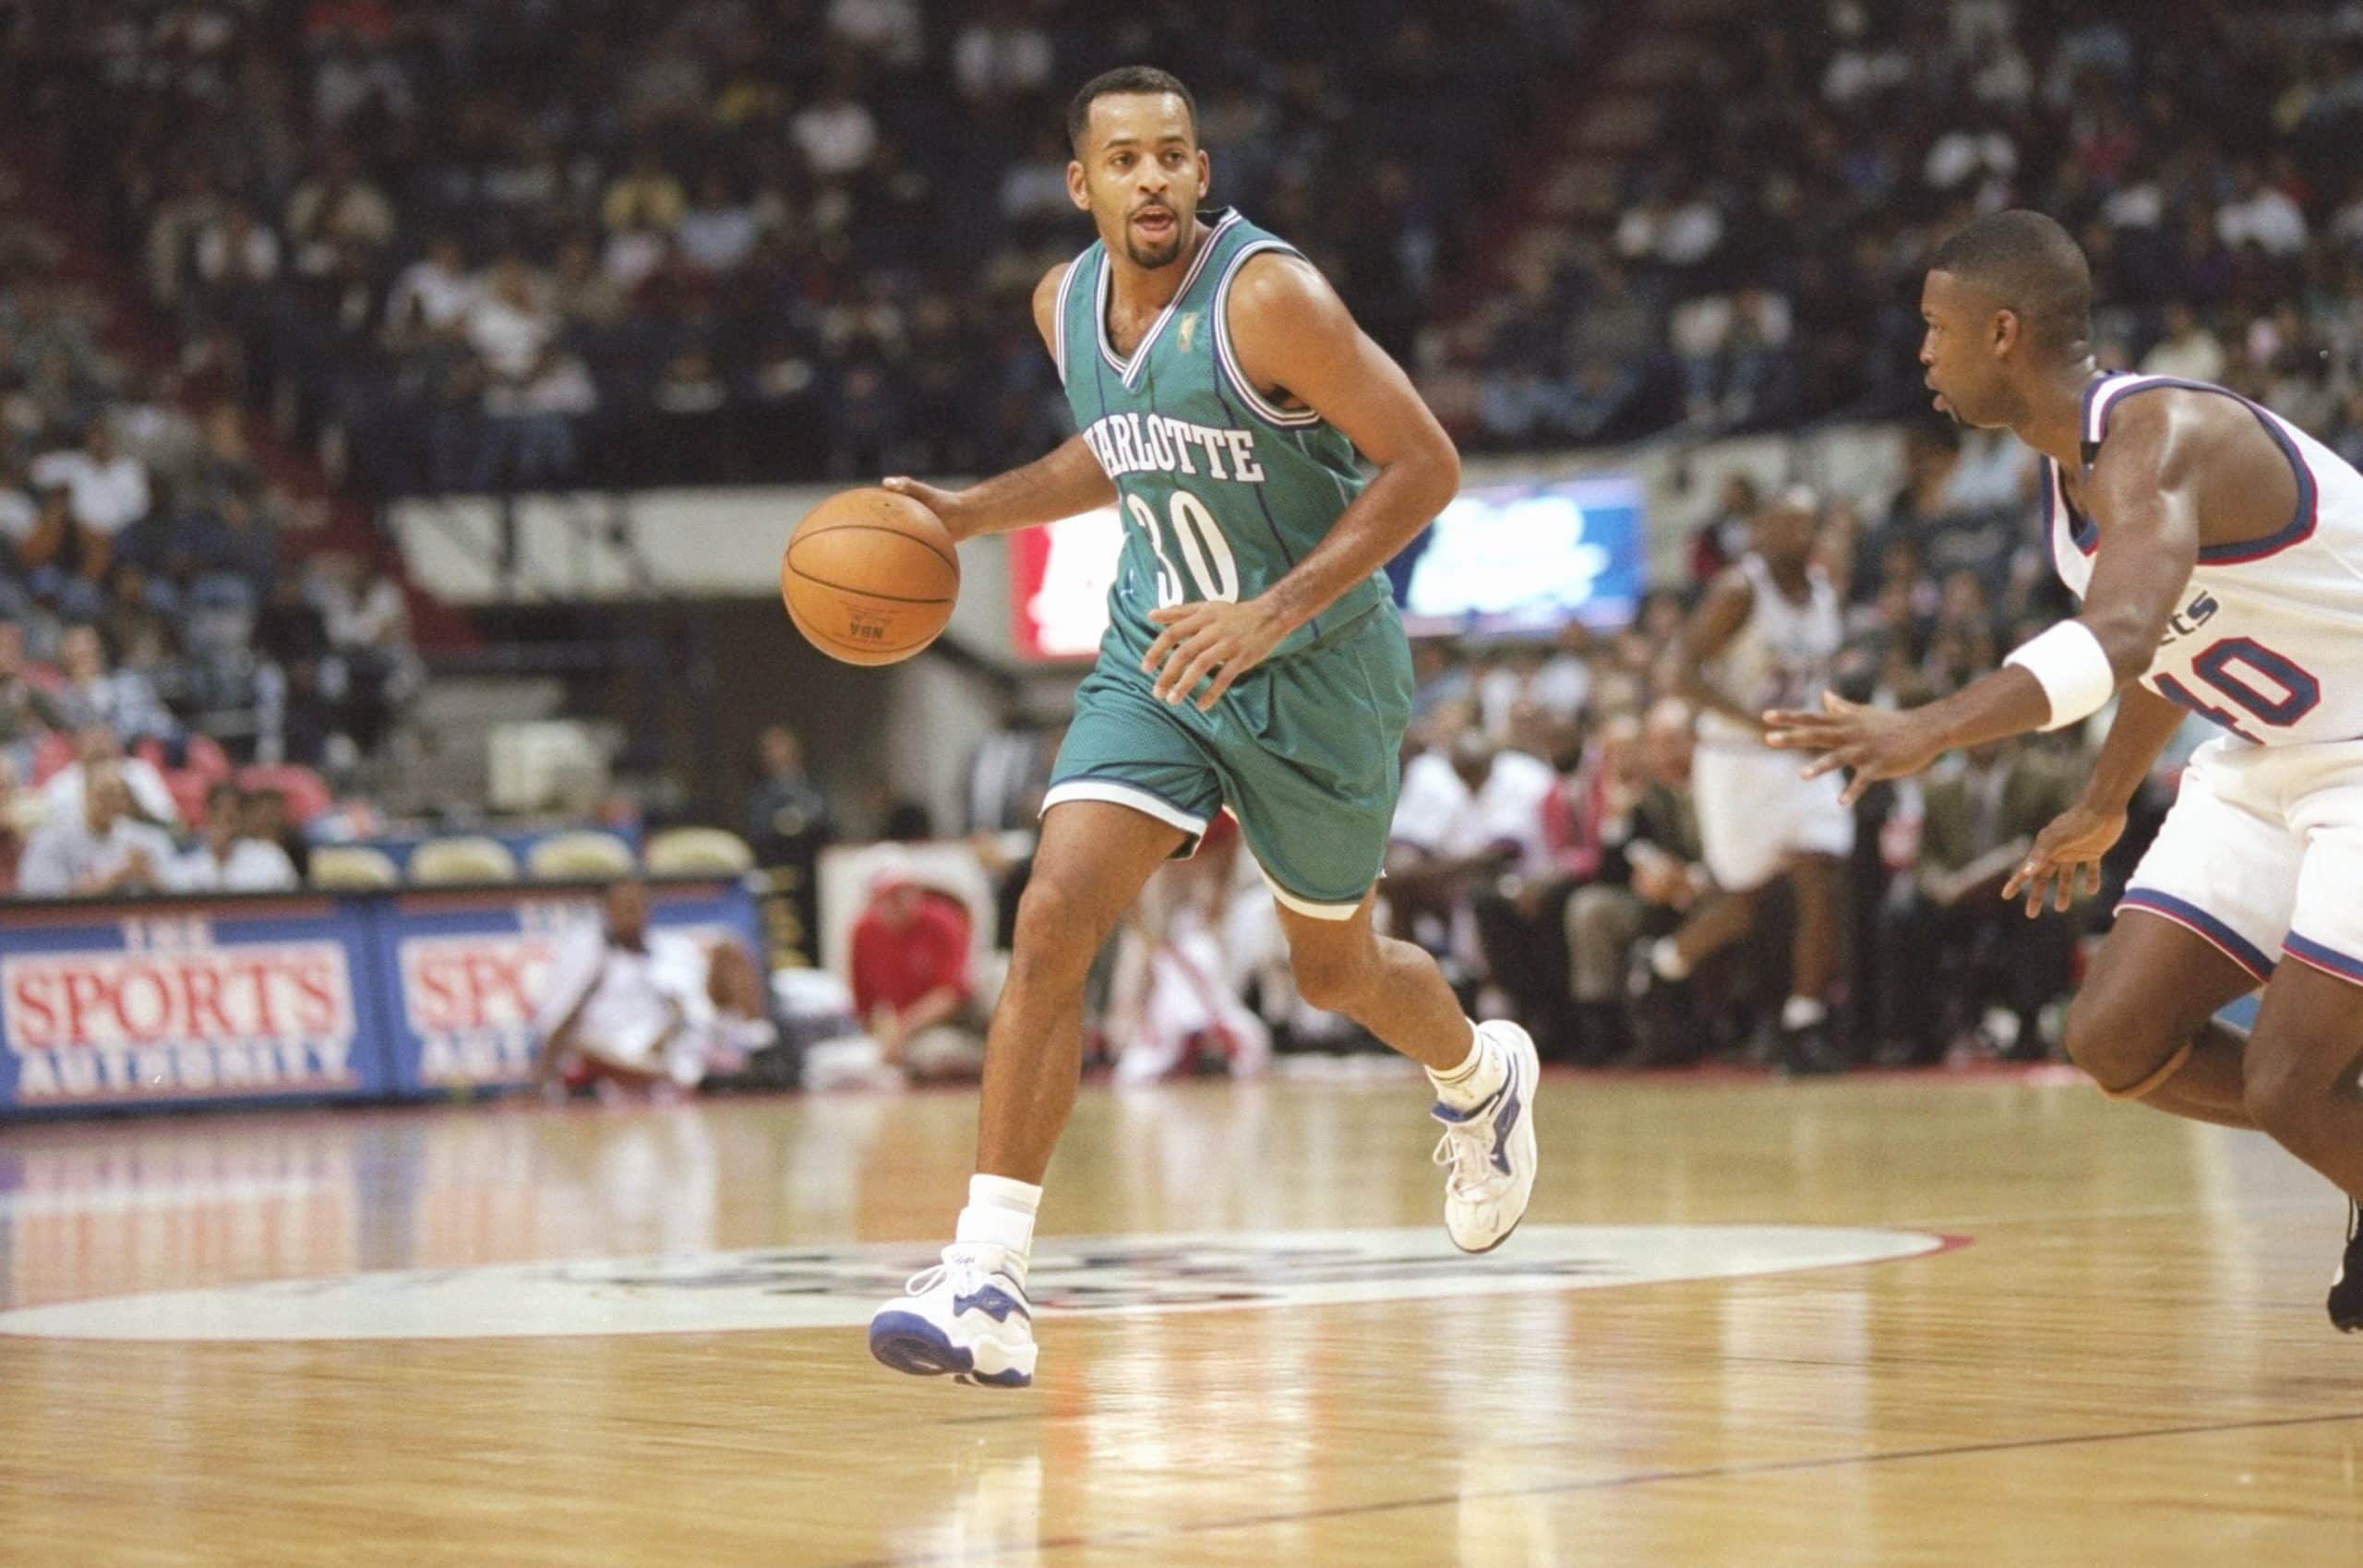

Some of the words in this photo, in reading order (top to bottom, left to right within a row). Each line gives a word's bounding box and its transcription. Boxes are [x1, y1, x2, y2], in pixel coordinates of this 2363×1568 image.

[1126, 490, 1239, 610] 30
[850, 619, 884, 640] NBA
[14, 960, 340, 1052] SPORTS
